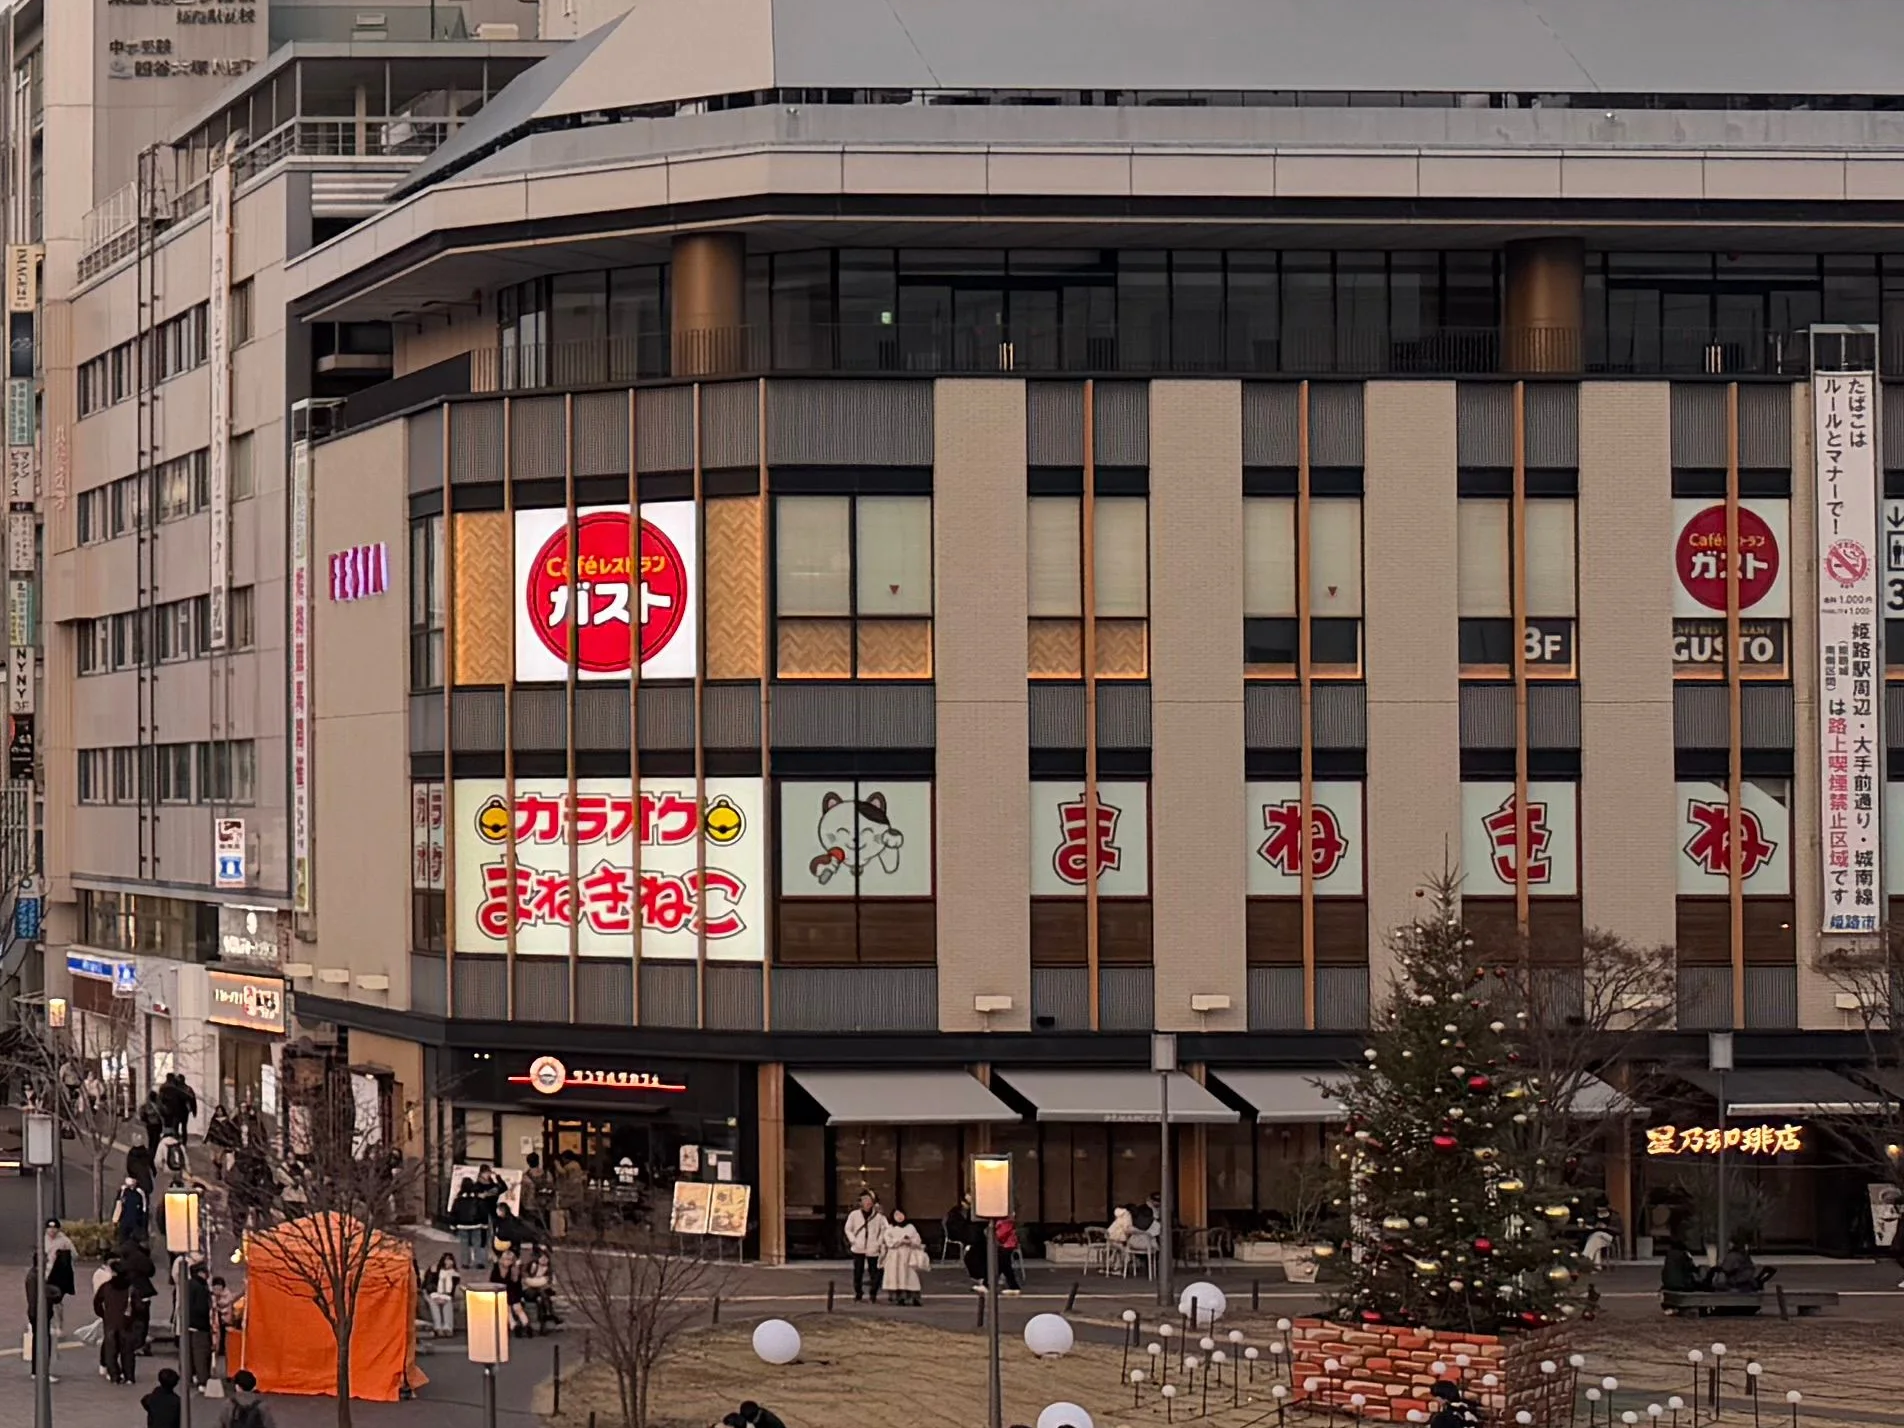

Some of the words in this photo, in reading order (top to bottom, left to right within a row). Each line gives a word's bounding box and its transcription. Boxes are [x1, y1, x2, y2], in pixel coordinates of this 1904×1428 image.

[1848, 377, 1867, 448] たばこは
[548, 581, 672, 627] ガスト
[510, 794, 704, 846] カラオケ
[476, 856, 747, 939] まねきねこ
[1829, 913, 1877, 930] 姫路市
[1645, 1123, 1805, 1158] 星乃珈琲店
